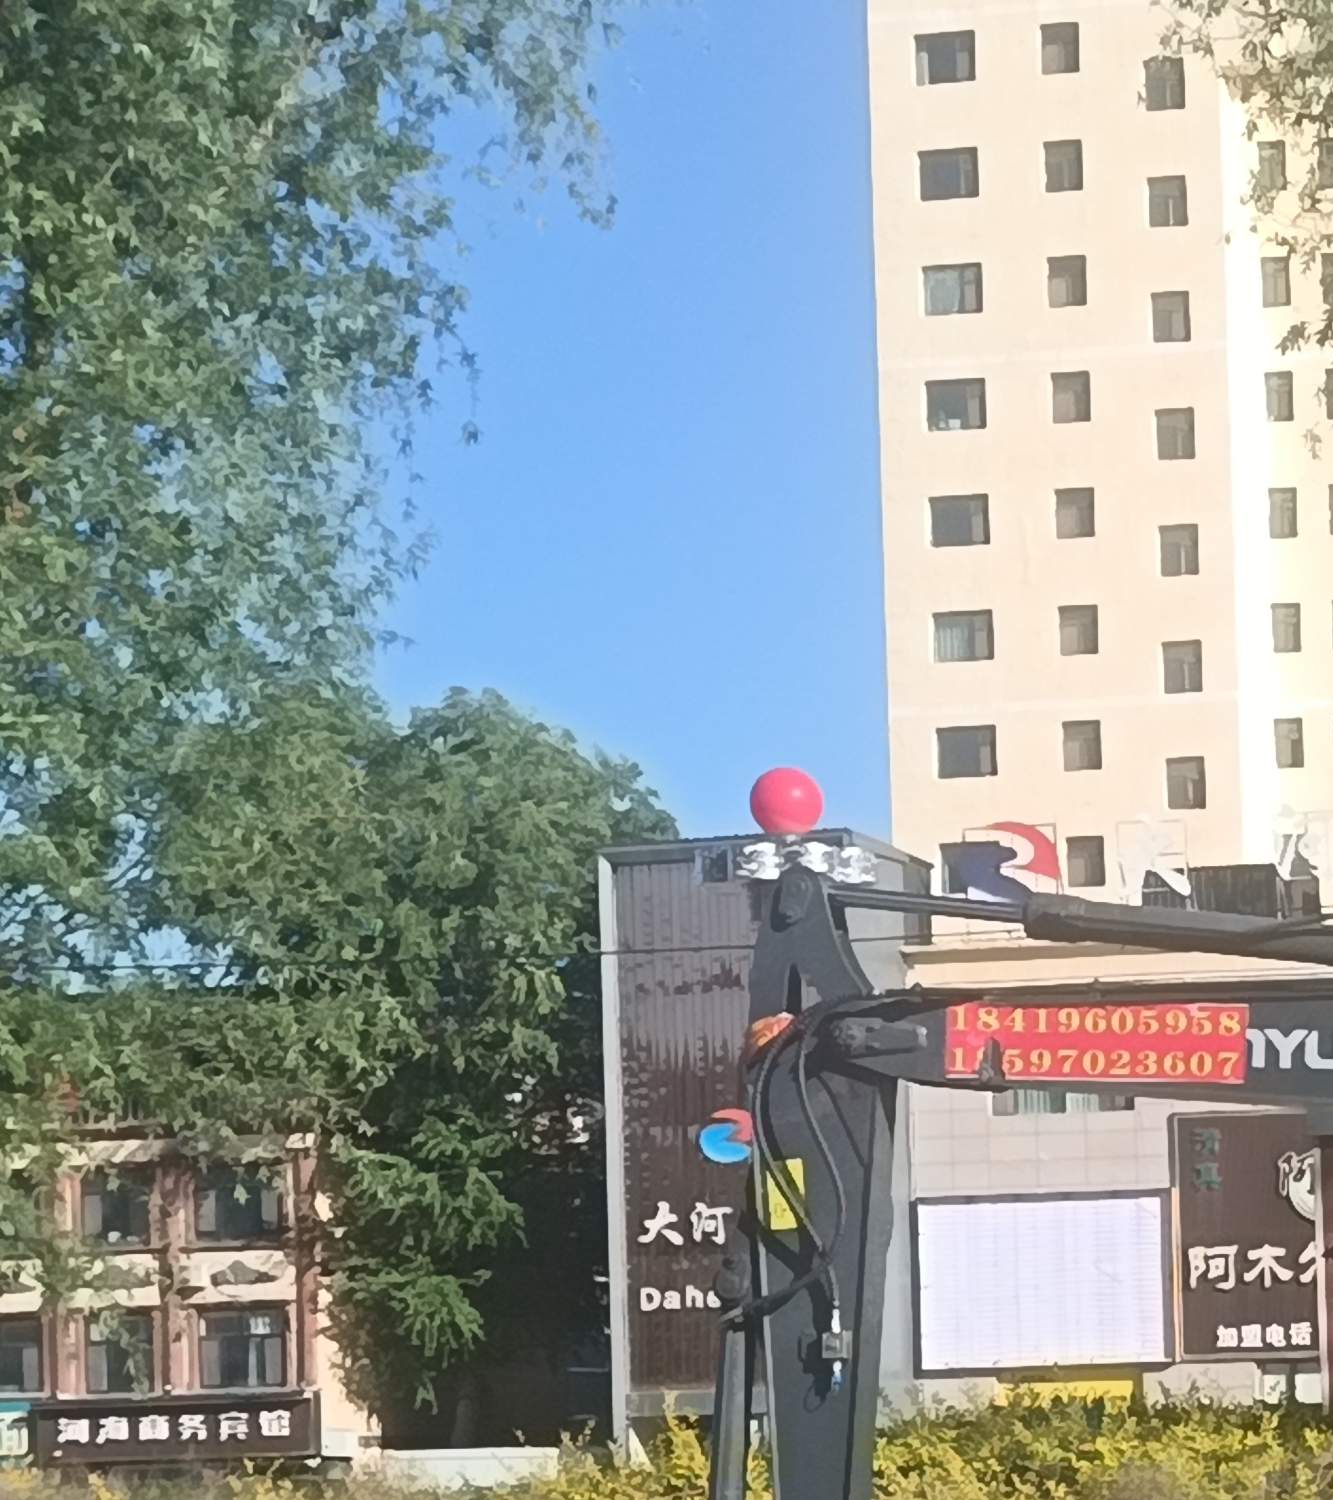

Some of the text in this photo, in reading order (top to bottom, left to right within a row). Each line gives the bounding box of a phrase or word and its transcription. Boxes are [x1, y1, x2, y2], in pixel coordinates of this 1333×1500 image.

[950, 1003, 1243, 1035] 18419605958
[635, 1200, 735, 1247] 大河
[1215, 1321, 1314, 1349] 加盟电话
